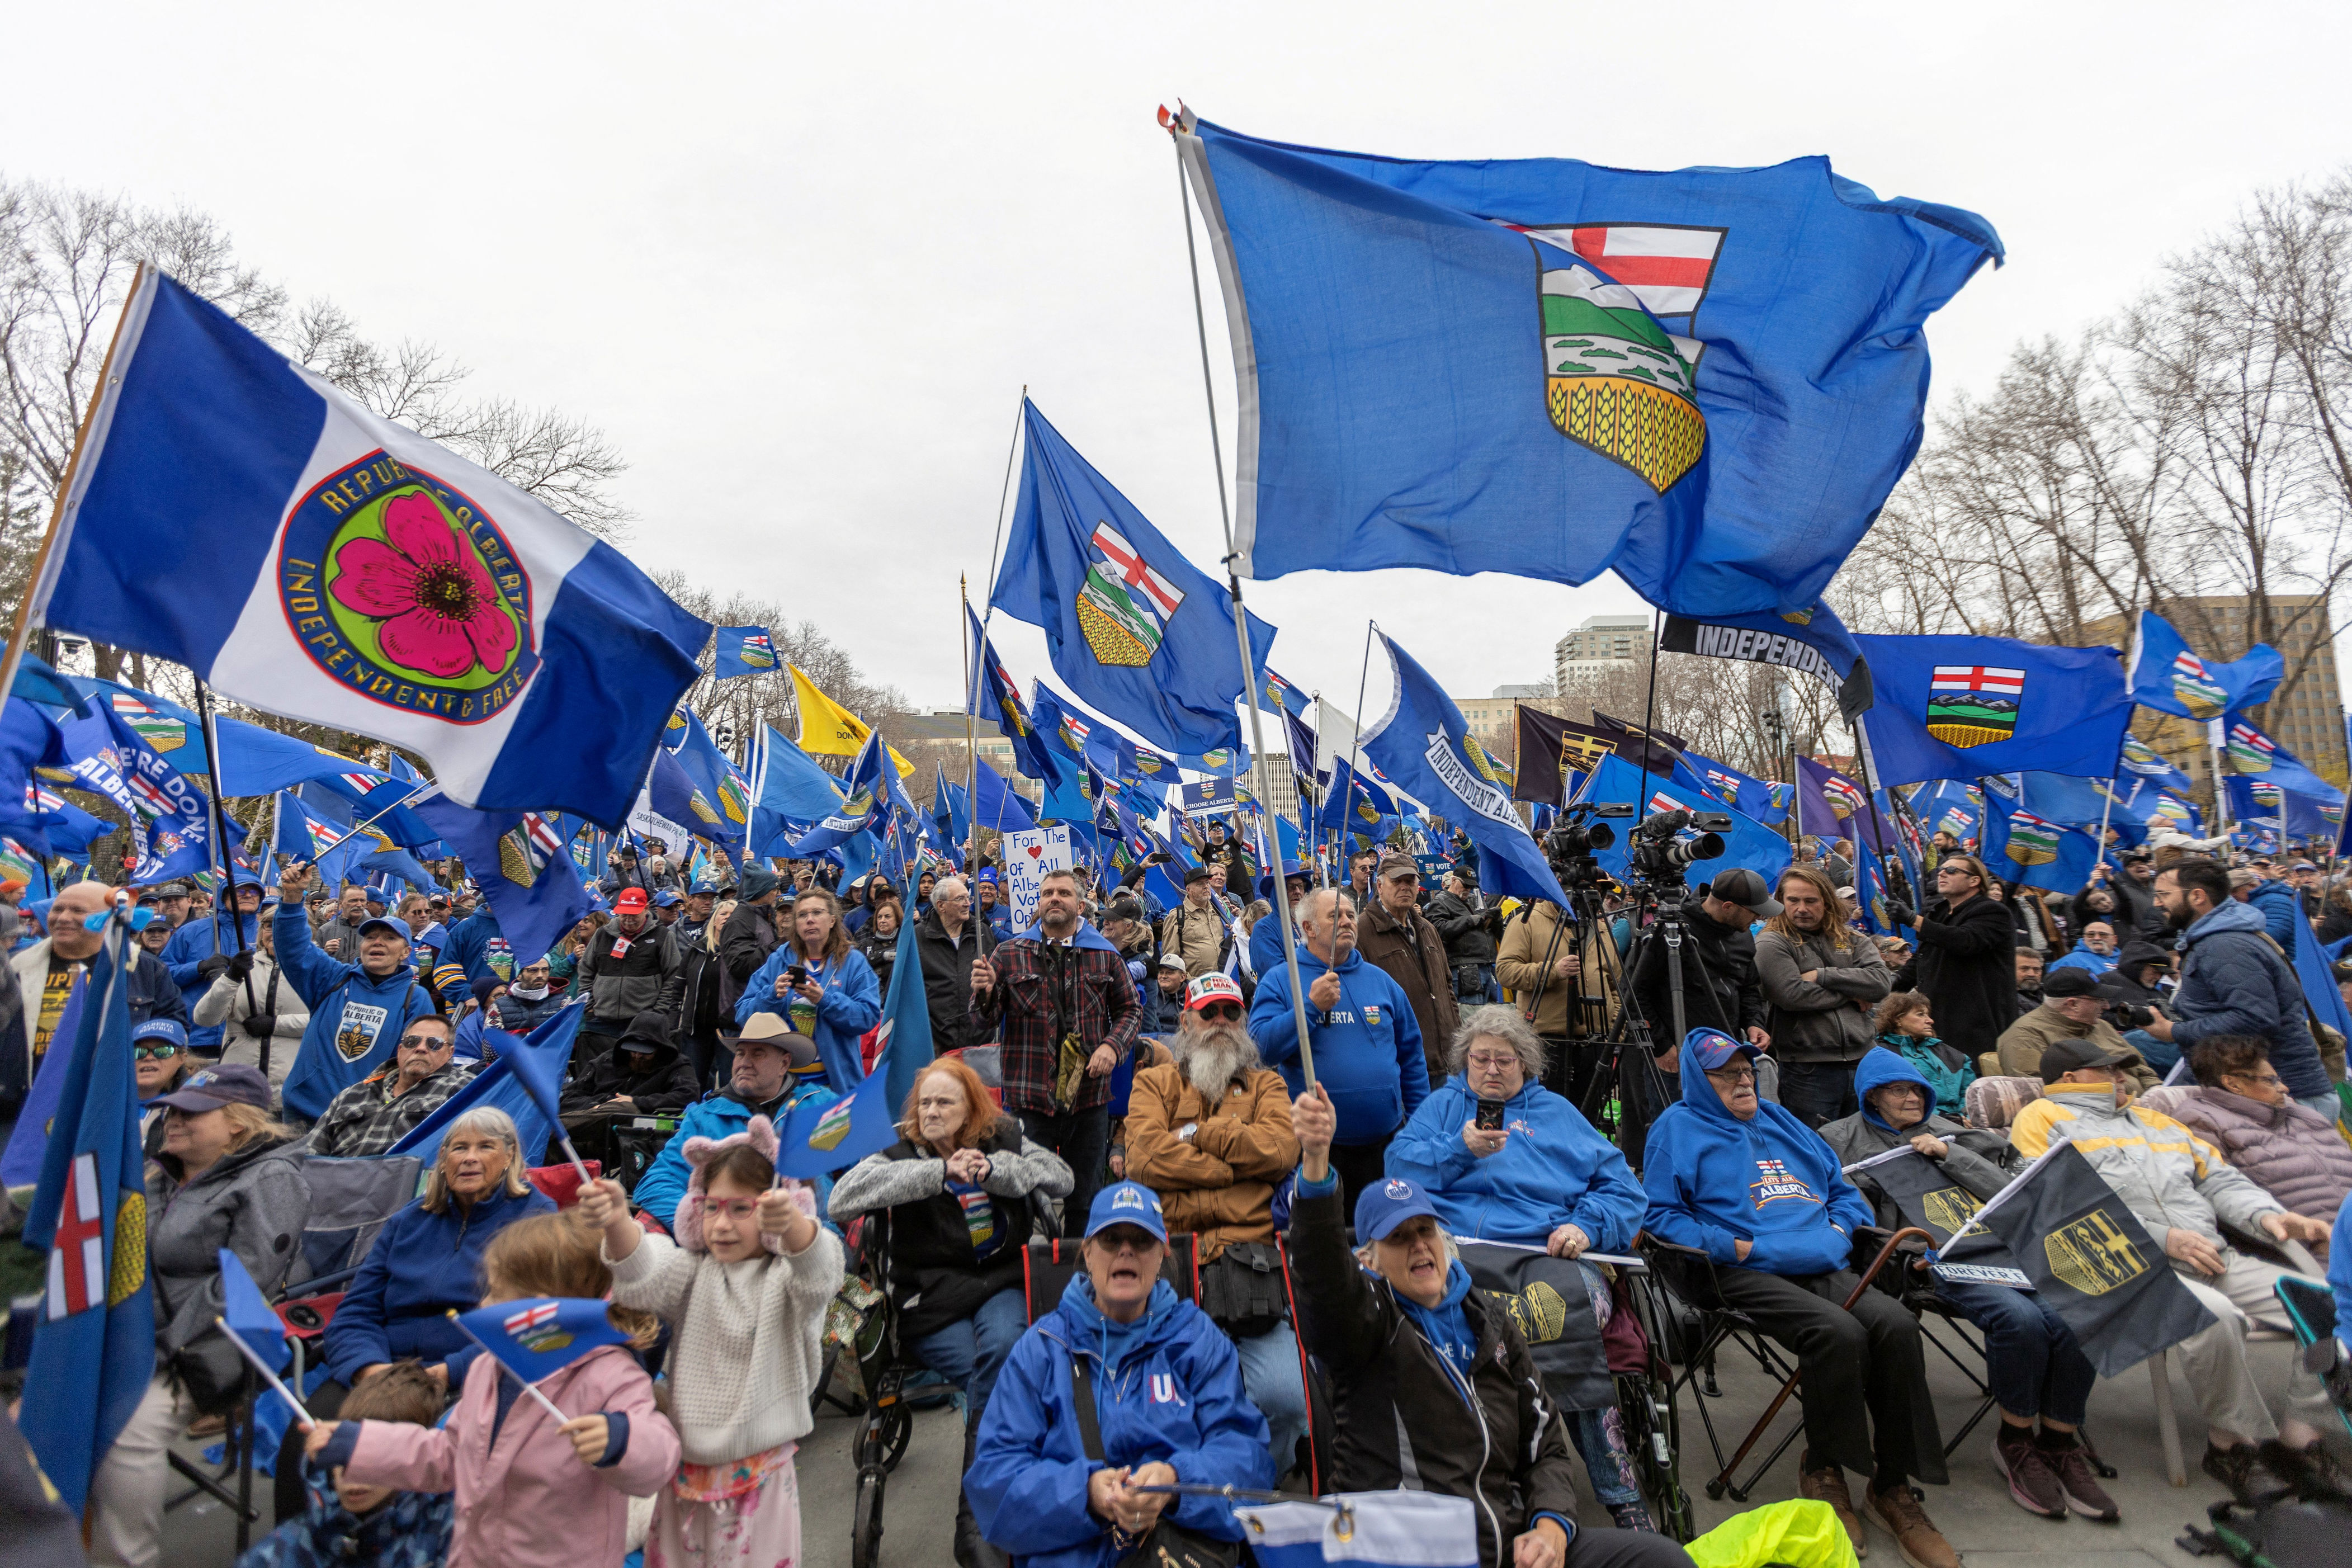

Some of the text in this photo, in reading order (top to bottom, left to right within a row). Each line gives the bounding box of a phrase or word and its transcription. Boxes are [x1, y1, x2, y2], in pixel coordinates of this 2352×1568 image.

[287, 558, 525, 717] INDEPENDENT & FREE
[837, 731, 853, 740] DON
[1430, 744, 1496, 813] INDEPENDENT
[119, 747, 169, 781] E'RE
[164, 775, 206, 844] DONE
[1186, 801, 1208, 809] CHOOSE
[636, 812, 673, 832] SASKATCHEWAN
[1013, 828, 1065, 848] For The
[1010, 858, 1059, 876] Of All
[1012, 877, 1040, 892] Albe
[1017, 891, 1040, 906] Vot
[1014, 908, 1034, 928] Opt
[346, 1004, 376, 1014] REPUBLIC
[343, 1010, 382, 1024] ALBERTA
[1316, 1011, 1355, 1024] LERTA
[1760, 1183, 1811, 1198] ALBERTA
[1936, 1265, 2012, 1279] FOREVER
